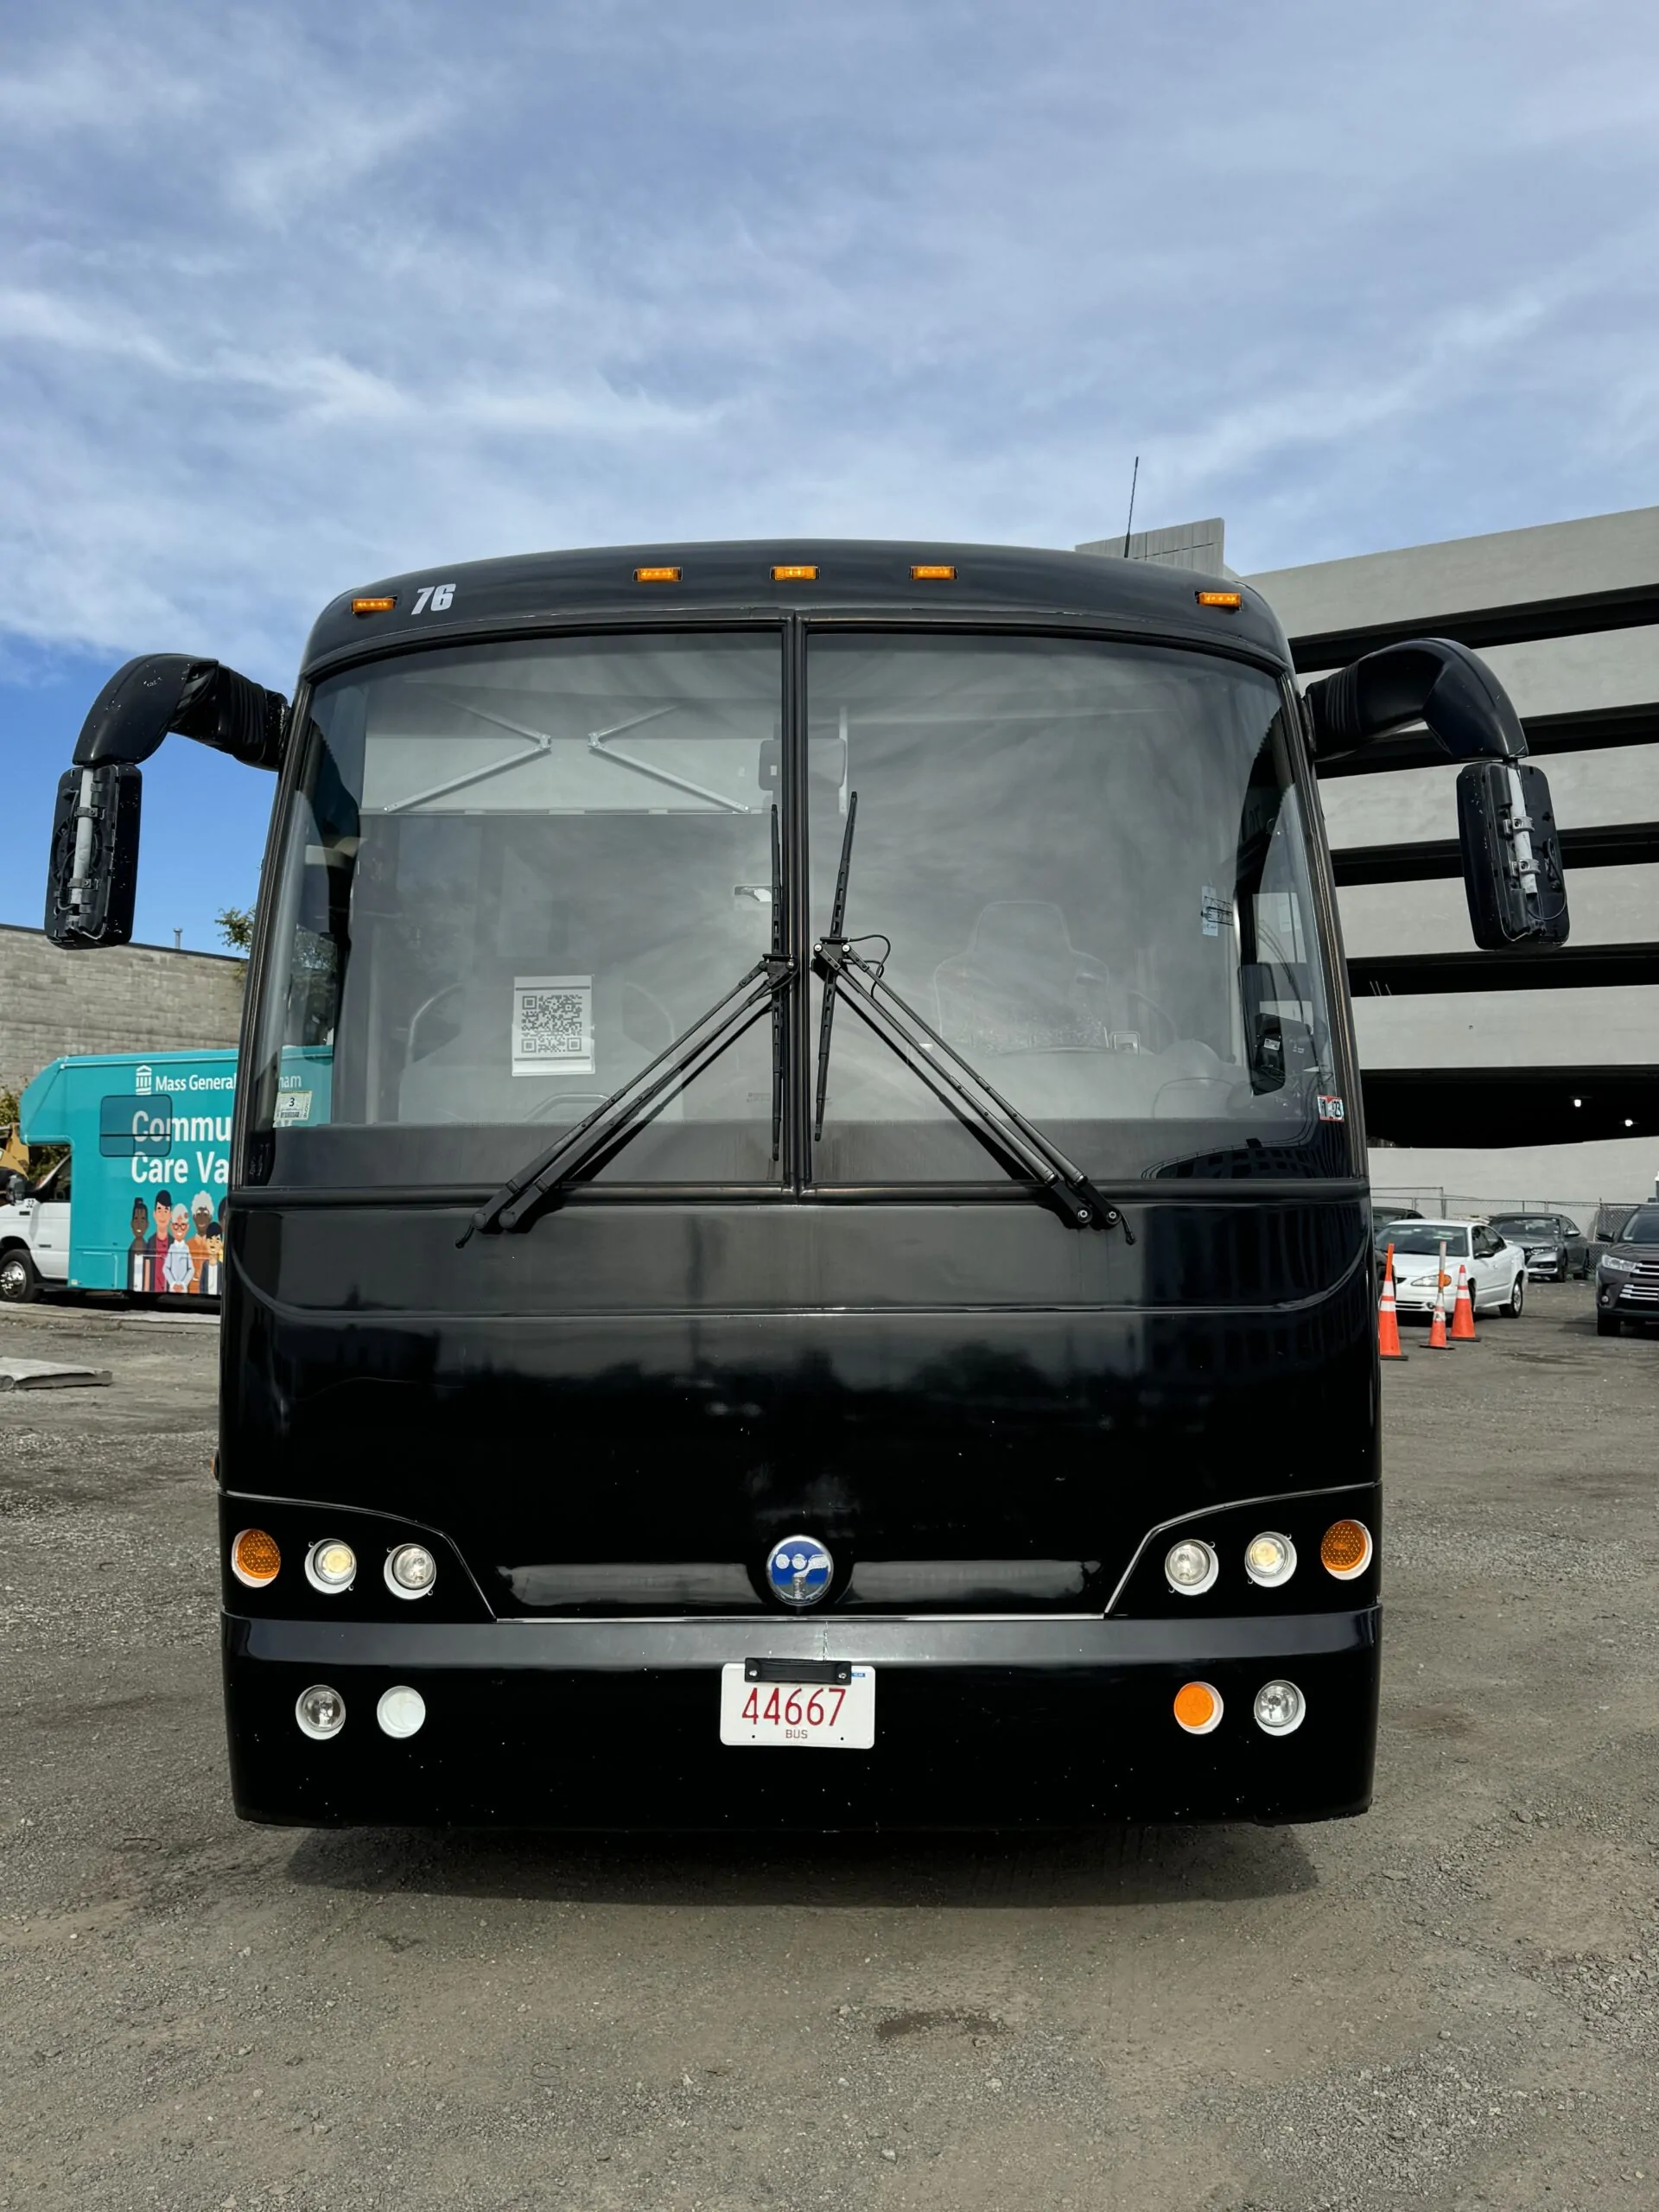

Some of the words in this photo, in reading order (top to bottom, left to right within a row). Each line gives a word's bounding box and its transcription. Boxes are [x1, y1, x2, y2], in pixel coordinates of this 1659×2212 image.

[411, 583, 456, 615] 76
[156, 1075, 187, 1091] Mass
[188, 1073, 238, 1090] General
[289, 1096, 296, 1107] 3
[132, 1110, 232, 1142] Commu
[131, 1151, 188, 1184] Care
[195, 1151, 230, 1184] Va
[741, 1688, 846, 1726] 44667
[785, 1729, 808, 1739] BUS
